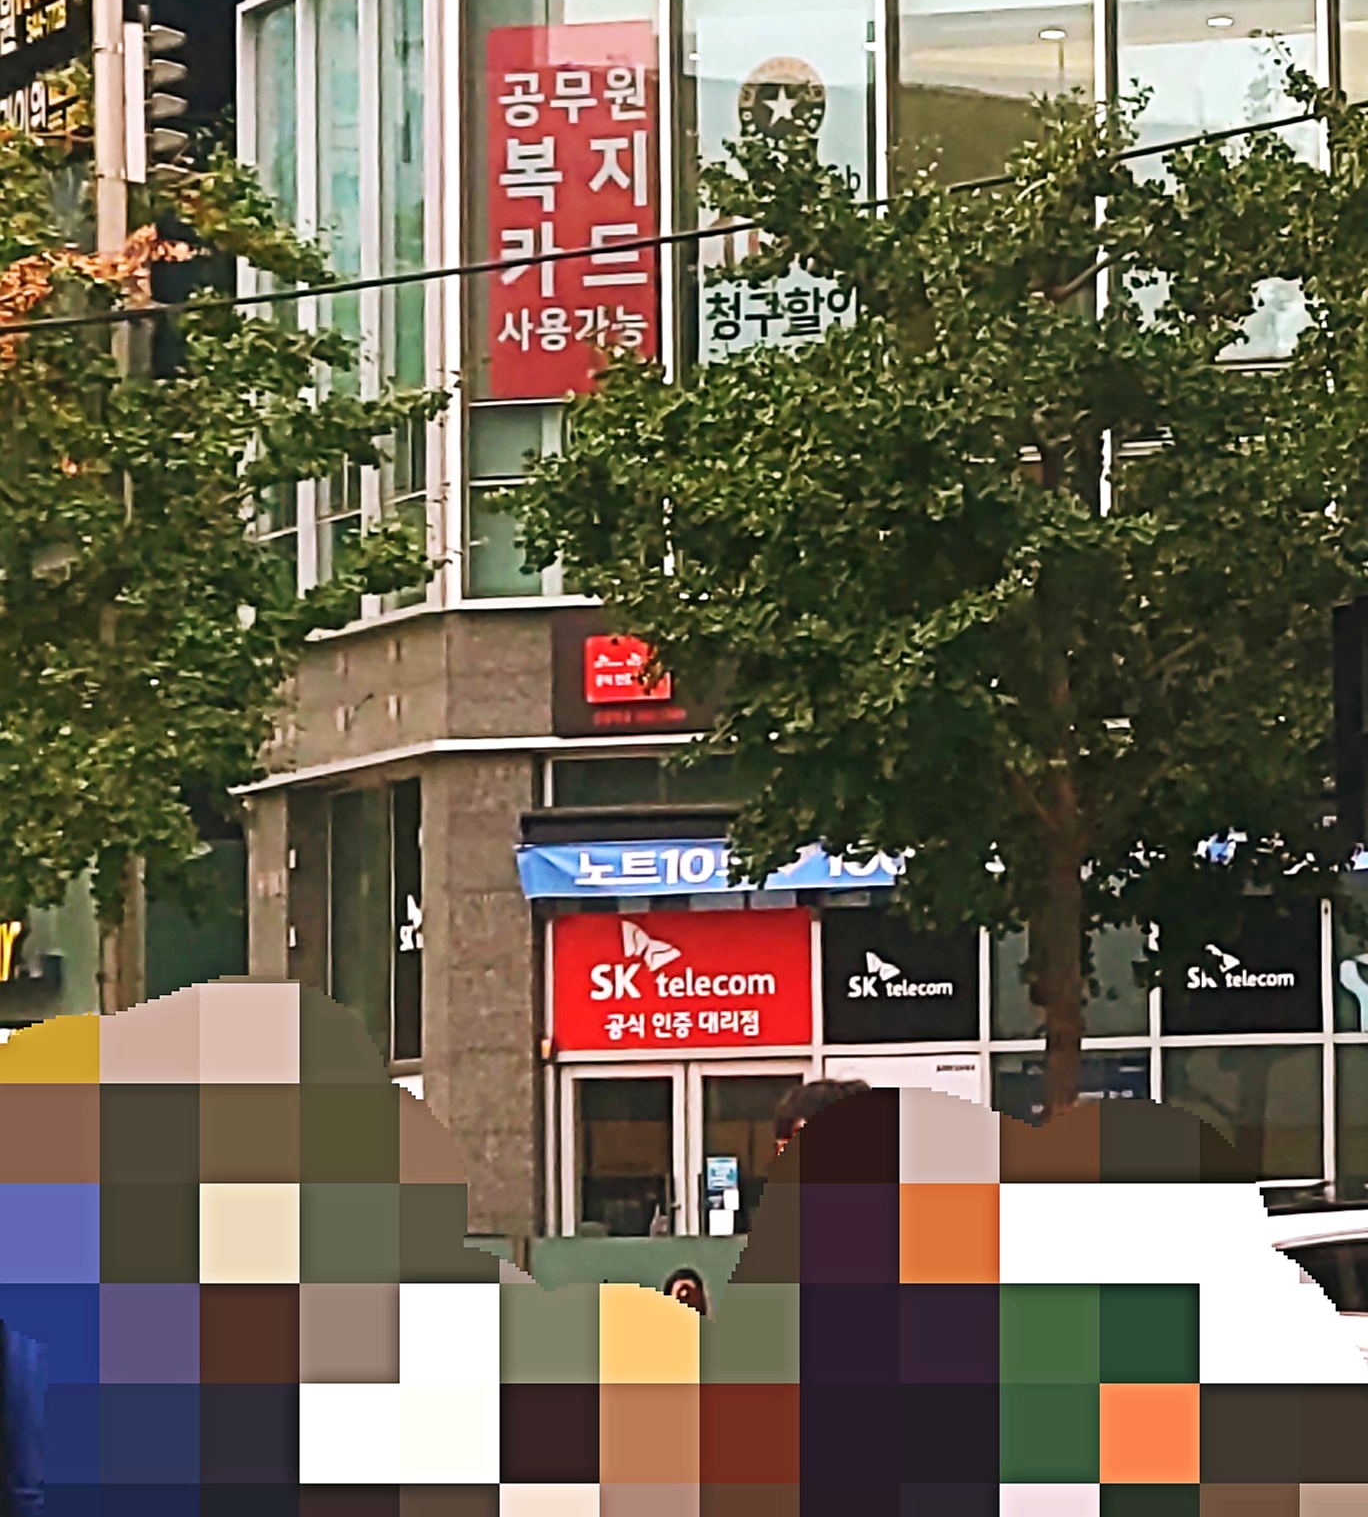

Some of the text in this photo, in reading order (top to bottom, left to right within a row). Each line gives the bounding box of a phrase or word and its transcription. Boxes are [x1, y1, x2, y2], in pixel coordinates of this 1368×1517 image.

[498, 67, 647, 127] 공무원
[498, 306, 648, 352] 사용가능
[589, 964, 776, 1000] SK telecom
[847, 975, 953, 999] SK telecom
[1225, 969, 1295, 988] telecom
[603, 1011, 760, 1040] 공식 인증 대리점
